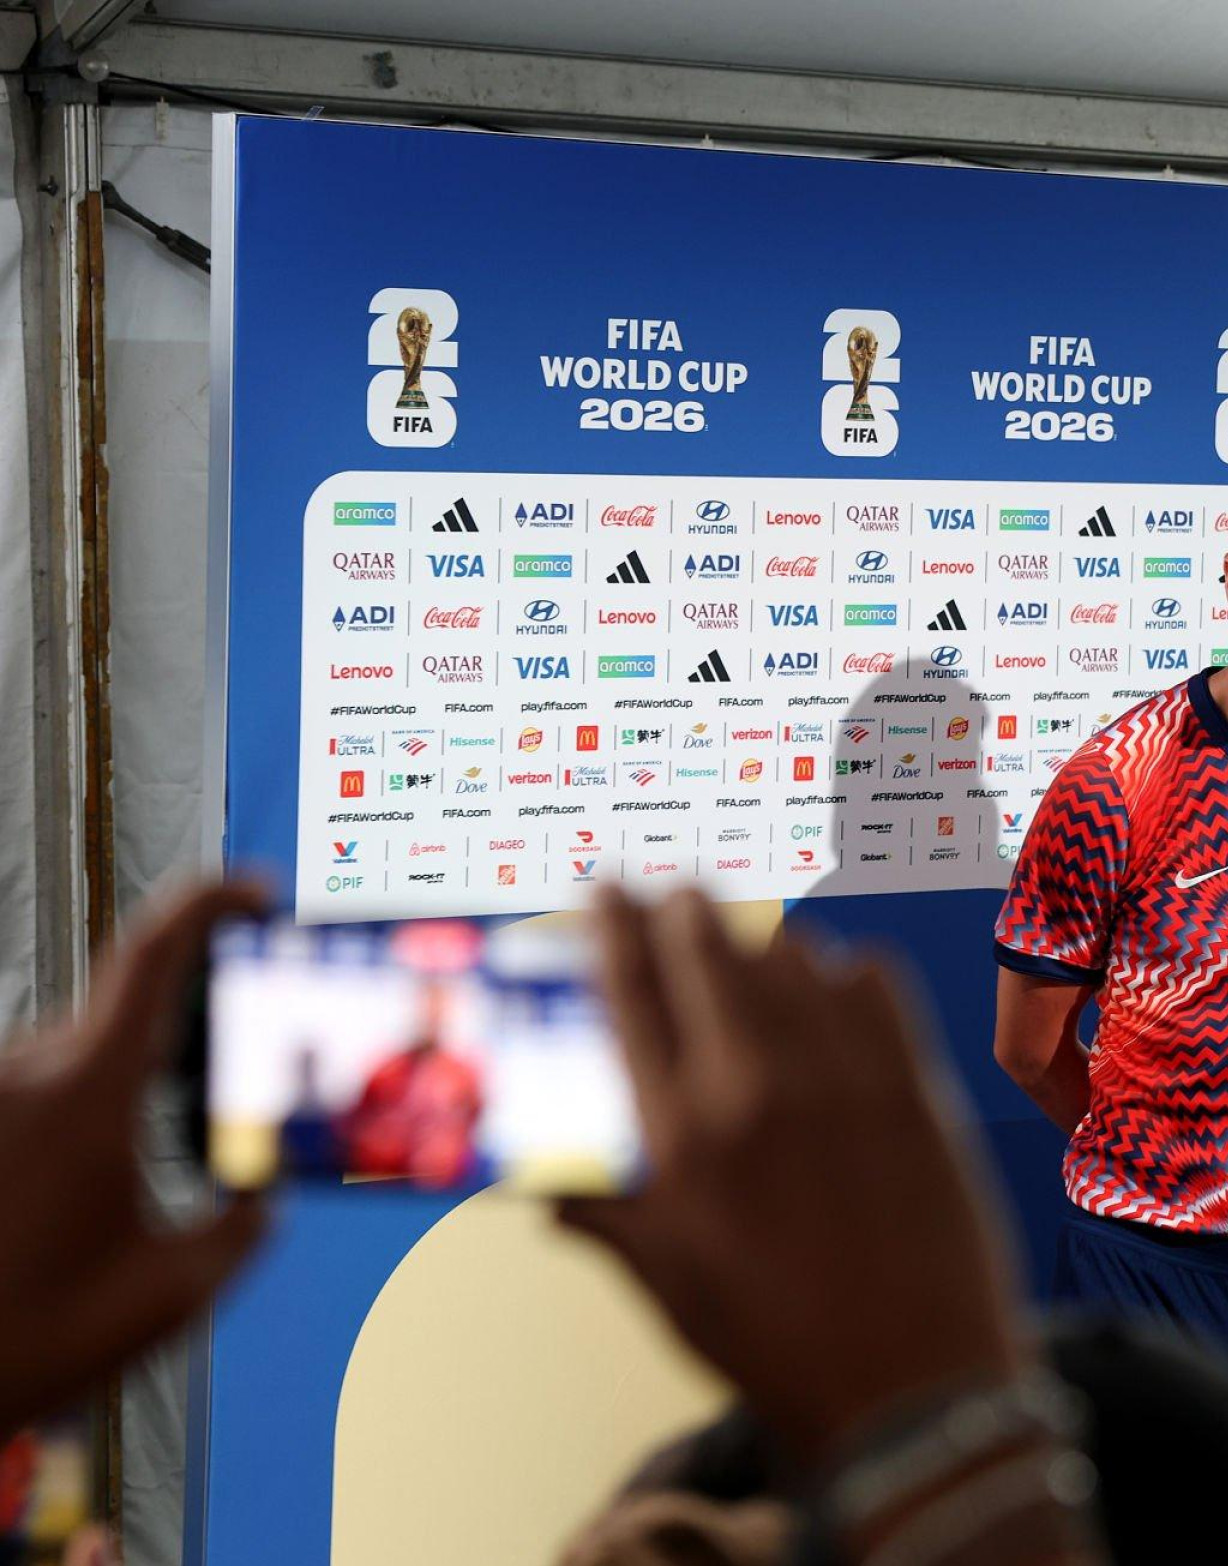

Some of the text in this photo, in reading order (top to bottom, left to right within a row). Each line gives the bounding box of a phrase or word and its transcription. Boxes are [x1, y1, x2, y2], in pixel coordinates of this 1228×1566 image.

[608, 318, 683, 351] FIFA
[1030, 336, 1095, 366] FIFA
[540, 356, 747, 392] WORLD CUP
[971, 371, 1152, 405] WORLD CUP
[580, 398, 704, 432] 2026
[394, 417, 433, 432] FIFA
[1005, 410, 1114, 442] 2026
[844, 428, 877, 443] FIFA
[336, 508, 394, 520] aramco
[531, 503, 573, 520] ADI
[847, 506, 898, 523] QATAR
[767, 511, 821, 525] Lenovo
[925, 509, 975, 529] VISA
[1001, 514, 1048, 526] aramco
[1159, 511, 1193, 526] ADI
[689, 525, 737, 534] HYUNDAI
[860, 522, 899, 531] AIRWAYS
[333, 553, 394, 571] QATAR
[426, 555, 484, 577] VISA
[515, 561, 571, 572] aramco
[699, 555, 739, 571] ADI
[923, 560, 974, 574] Lenovo
[998, 555, 1047, 572] QATAR
[1073, 558, 1120, 577] VISA
[1146, 562, 1190, 573] aramco
[348, 570, 395, 580] AIRWAYS
[848, 575, 894, 583] HYUNDAI
[1011, 571, 1048, 579] AIRWAYS
[349, 606, 394, 624] ADI
[599, 609, 656, 624] Lenovo
[683, 603, 738, 620] QATAR
[766, 605, 818, 626] VISA
[846, 609, 895, 621] aramco
[1011, 603, 1047, 618] ADI
[516, 625, 567, 634] HYUNDAI
[697, 620, 738, 629] AIRWAYS
[1145, 620, 1187, 629] HYUNDAI
[779, 653, 817, 669] ADI
[996, 654, 1046, 668] Lenovo
[1070, 648, 1117, 664] QATAR
[1143, 649, 1188, 669] VISA
[423, 656, 482, 674] QATAR
[513, 656, 570, 679] VISA
[600, 660, 653, 673] aramco
[1081, 663, 1118, 672] AIRWAYS
[331, 664, 393, 679] Lenovo
[924, 670, 969, 679] HYUNDAI
[438, 673, 483, 683] AIRWAYS
[719, 698, 763, 707] FIFA.com
[788, 696, 849, 707] play.fifa.com
[874, 694, 946, 703] #FIFAWorldCup
[970, 693, 1010, 701] FIFA.com
[1034, 691, 1089, 702] play.fifa.com
[331, 705, 416, 715] #FIFAWorldCup
[445, 703, 493, 712] FIFA.com
[521, 701, 587, 713] play.fifa.com
[614, 699, 692, 709] #FIFAWorldCup
[732, 728, 772, 740] verizon
[888, 726, 927, 734] Hisense
[450, 737, 495, 746] Hisense
[683, 735, 713, 748] Dove
[791, 733, 824, 743] ULTRA
[337, 747, 375, 755] ULTRA
[938, 758, 976, 770] verizon
[995, 763, 1024, 772] ULTRA
[676, 768, 718, 777] Hisense
[893, 765, 920, 778] Dove
[508, 772, 552, 784] verizon
[572, 776, 608, 786] ULTRA
[455, 779, 487, 793] Dove
[871, 792, 943, 801] #FIFAWorldCup
[967, 789, 1008, 798] FIFA.com
[612, 801, 690, 811] #FIFAWorldCup
[716, 799, 761, 807] FIFA.com
[786, 794, 847, 806] play.fifa.com
[443, 809, 491, 818] FIFA.com
[519, 805, 584, 816] play.fifa.com
[328, 811, 414, 823] #FIFAWorldCup
[805, 826, 822, 837] PIF
[489, 840, 525, 850] DIAGEO
[717, 859, 750, 869] DIAGEO
[343, 877, 363, 889] PIF
